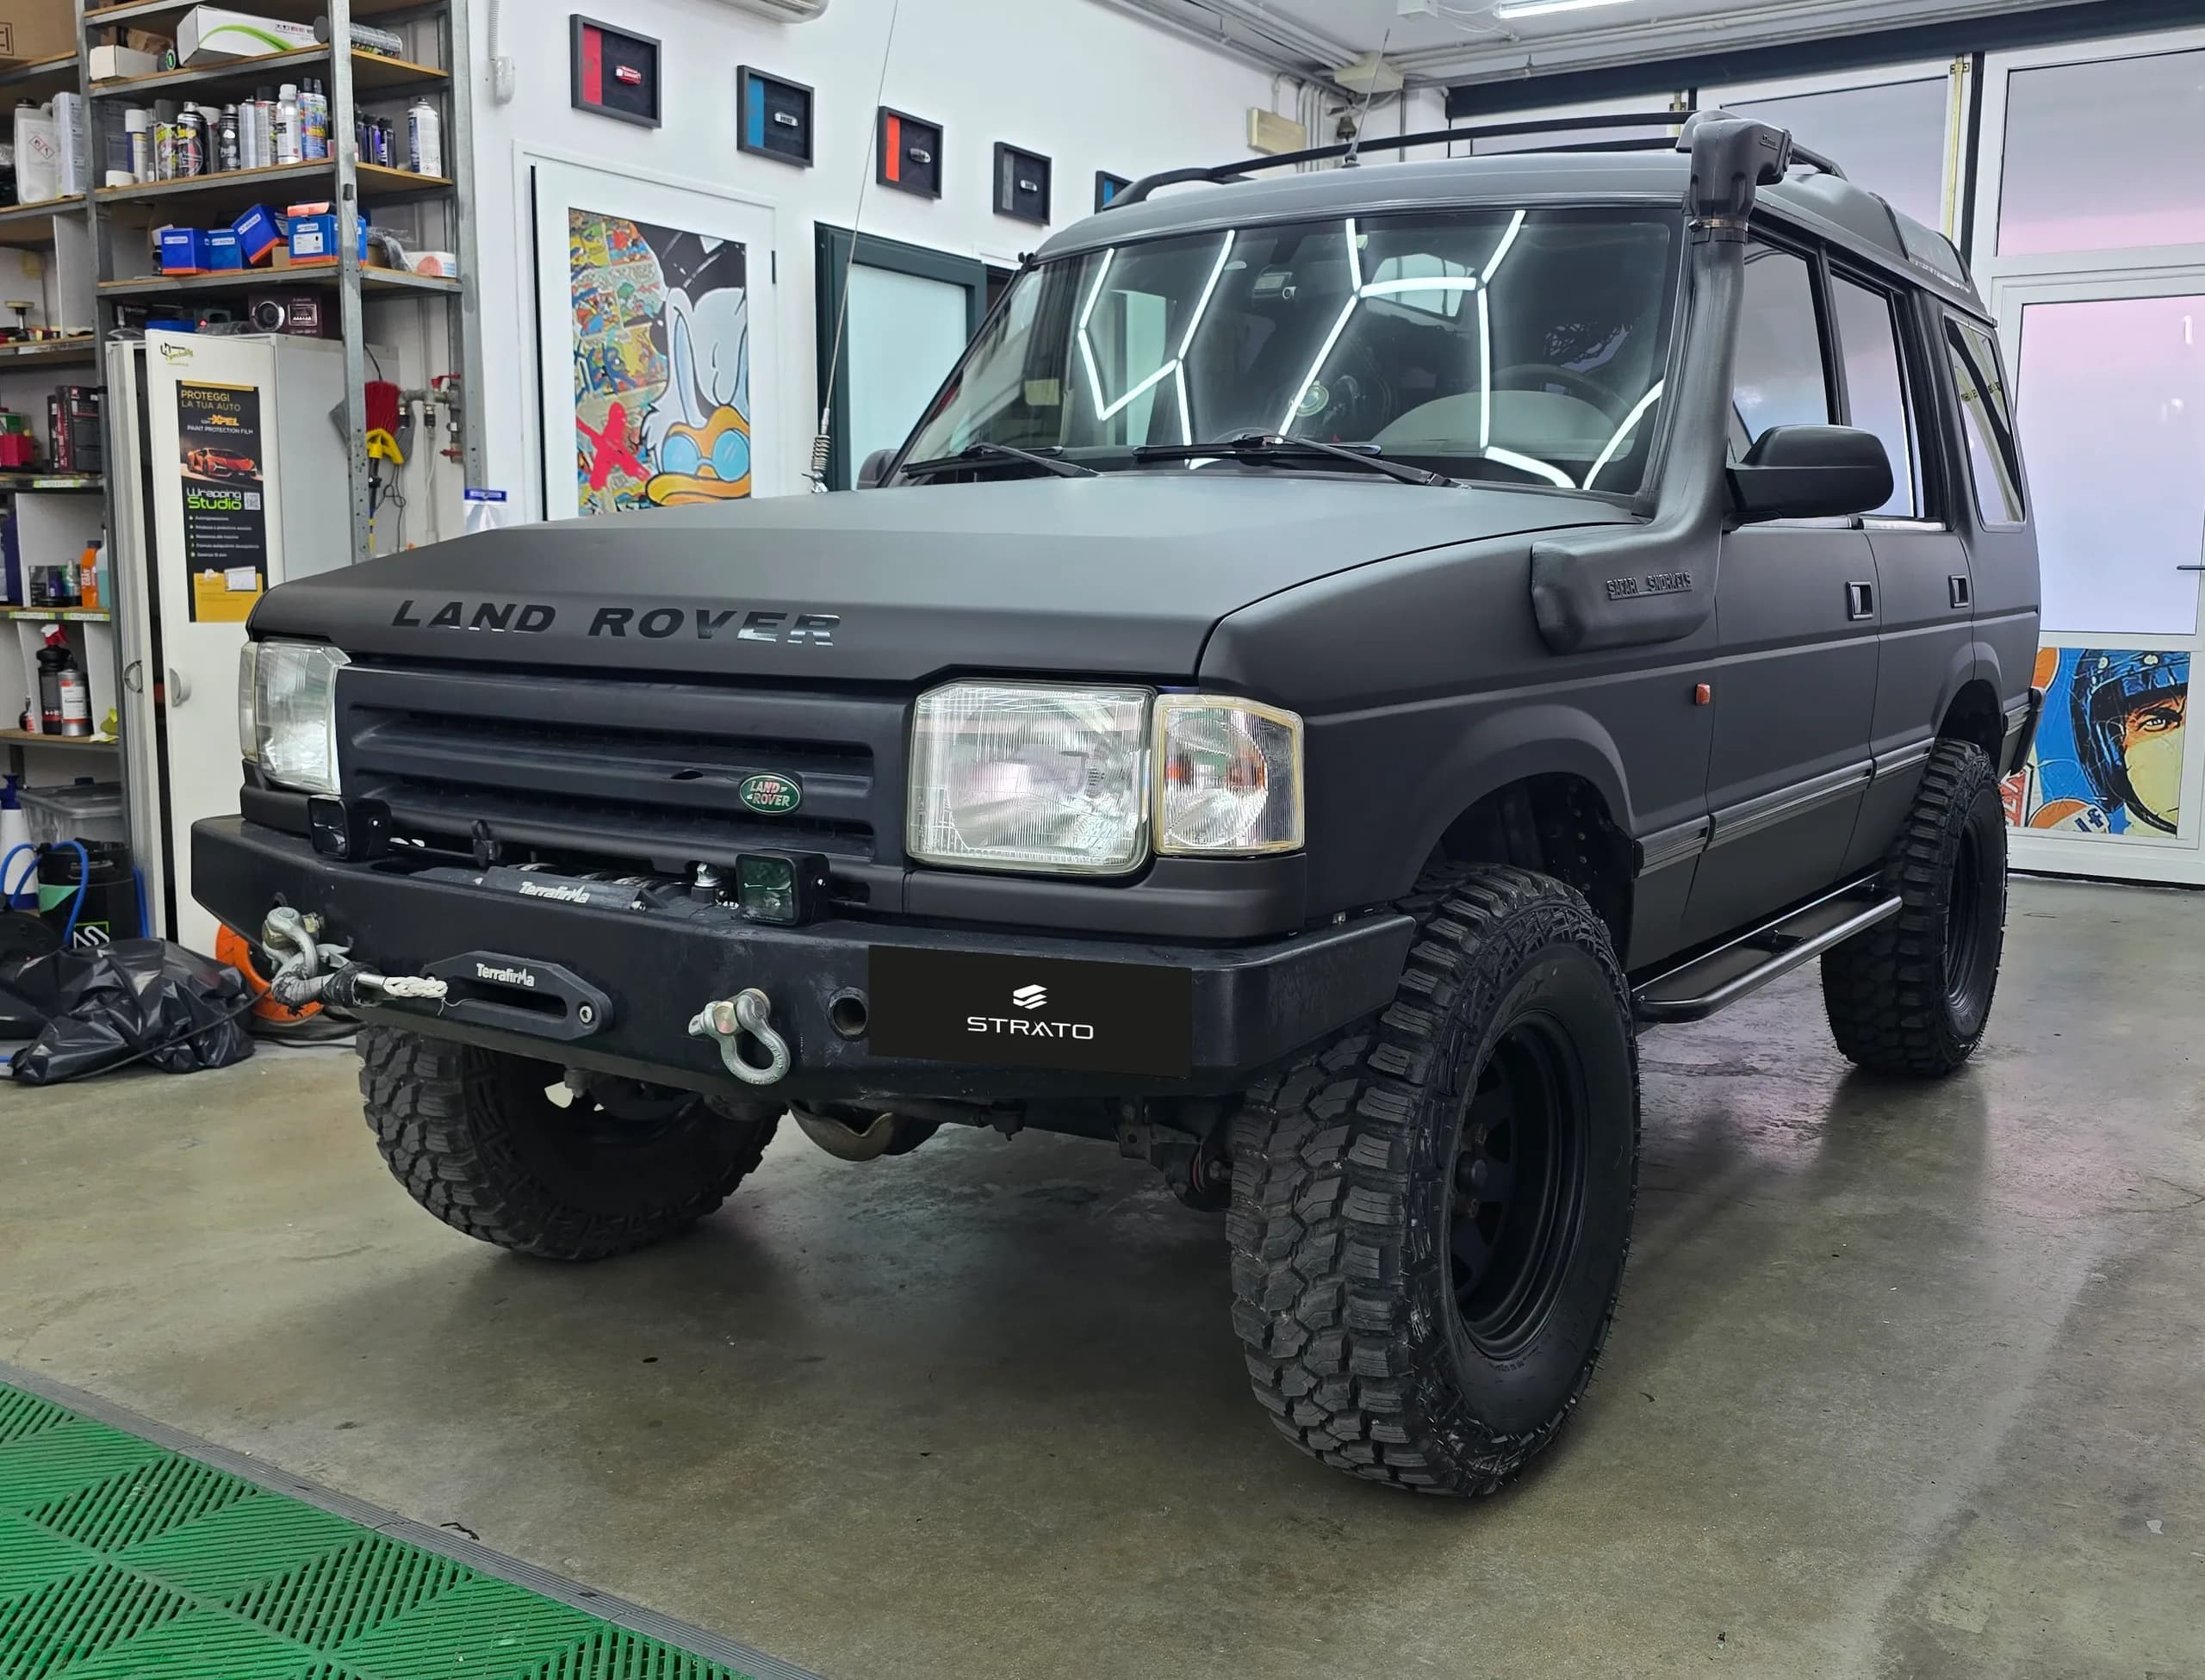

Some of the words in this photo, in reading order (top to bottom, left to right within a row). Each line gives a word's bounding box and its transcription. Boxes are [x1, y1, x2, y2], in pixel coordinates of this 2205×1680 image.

[181, 390, 230, 401] PROTEGGI
[181, 400, 193, 408] LA
[196, 400, 214, 410] TUA
[216, 403, 241, 412] AUTO
[186, 487, 242, 500] Wrapping
[187, 497, 242, 510] Studio
[391, 600, 556, 633] LAND
[588, 607, 842, 646] ROVER
[749, 780, 780, 794] LAND
[752, 793, 791, 807] ROVER
